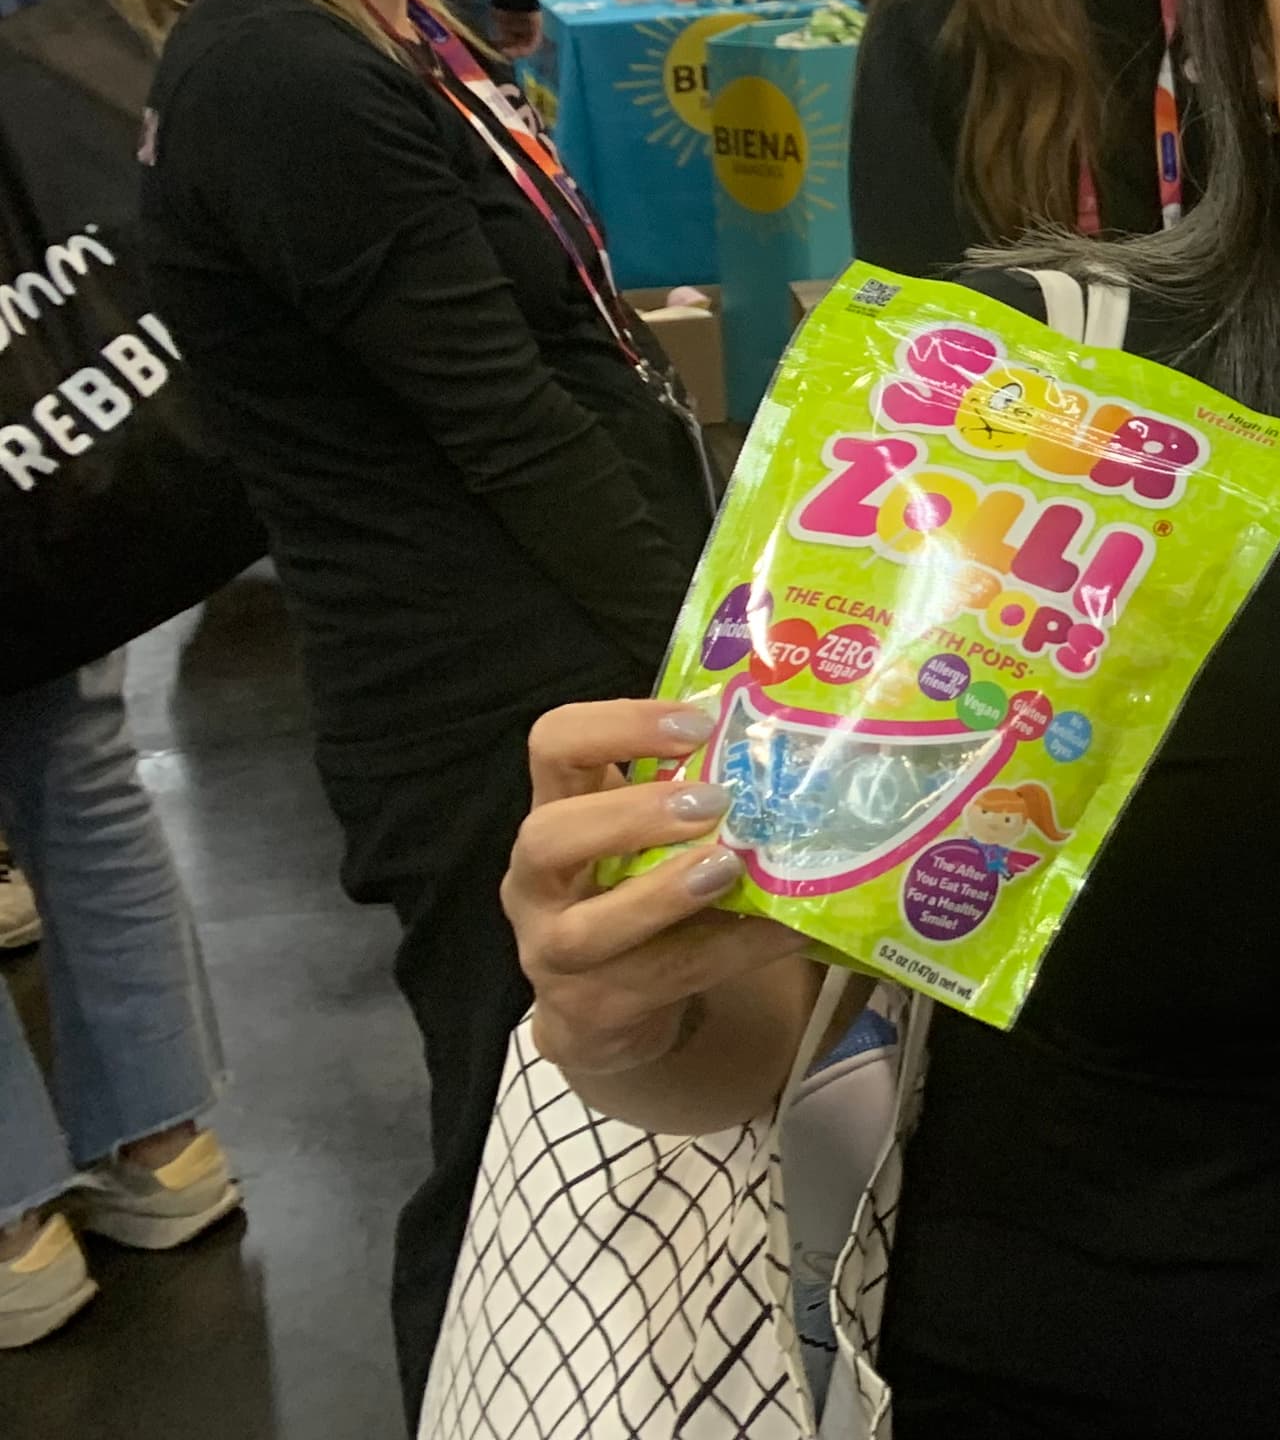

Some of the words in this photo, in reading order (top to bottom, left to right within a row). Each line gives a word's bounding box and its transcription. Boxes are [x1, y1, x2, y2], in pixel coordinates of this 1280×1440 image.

[713, 126, 801, 163] BIENA
[869, 321, 1209, 509] SOUR
[1196, 406, 1276, 448] Vitamin
[1227, 412, 1262, 436] High
[1264, 426, 1279, 438] in
[787, 430, 1156, 624] ZOLLI
[785, 586, 824, 607] THE
[825, 595, 894, 628] CLEAN
[967, 641, 1030, 680] POPS
[816, 635, 880, 670] ZERO
[818, 659, 858, 680] sugar
[927, 658, 969, 686] Allergy
[963, 692, 1001, 720] Vegan
[1013, 699, 1048, 726] Gluten
[933, 855, 956, 874] The
[955, 863, 987, 882] After
[916, 870, 938, 887] You
[939, 877, 960, 894] Eat
[960, 882, 990, 901] Treat
[907, 888, 925, 903] For
[928, 896, 938, 906] a
[937, 896, 984, 921] Healthy
[920, 910, 960, 931] Smile!
[878, 944, 896, 962] 5.2
[938, 977, 957, 992] net
